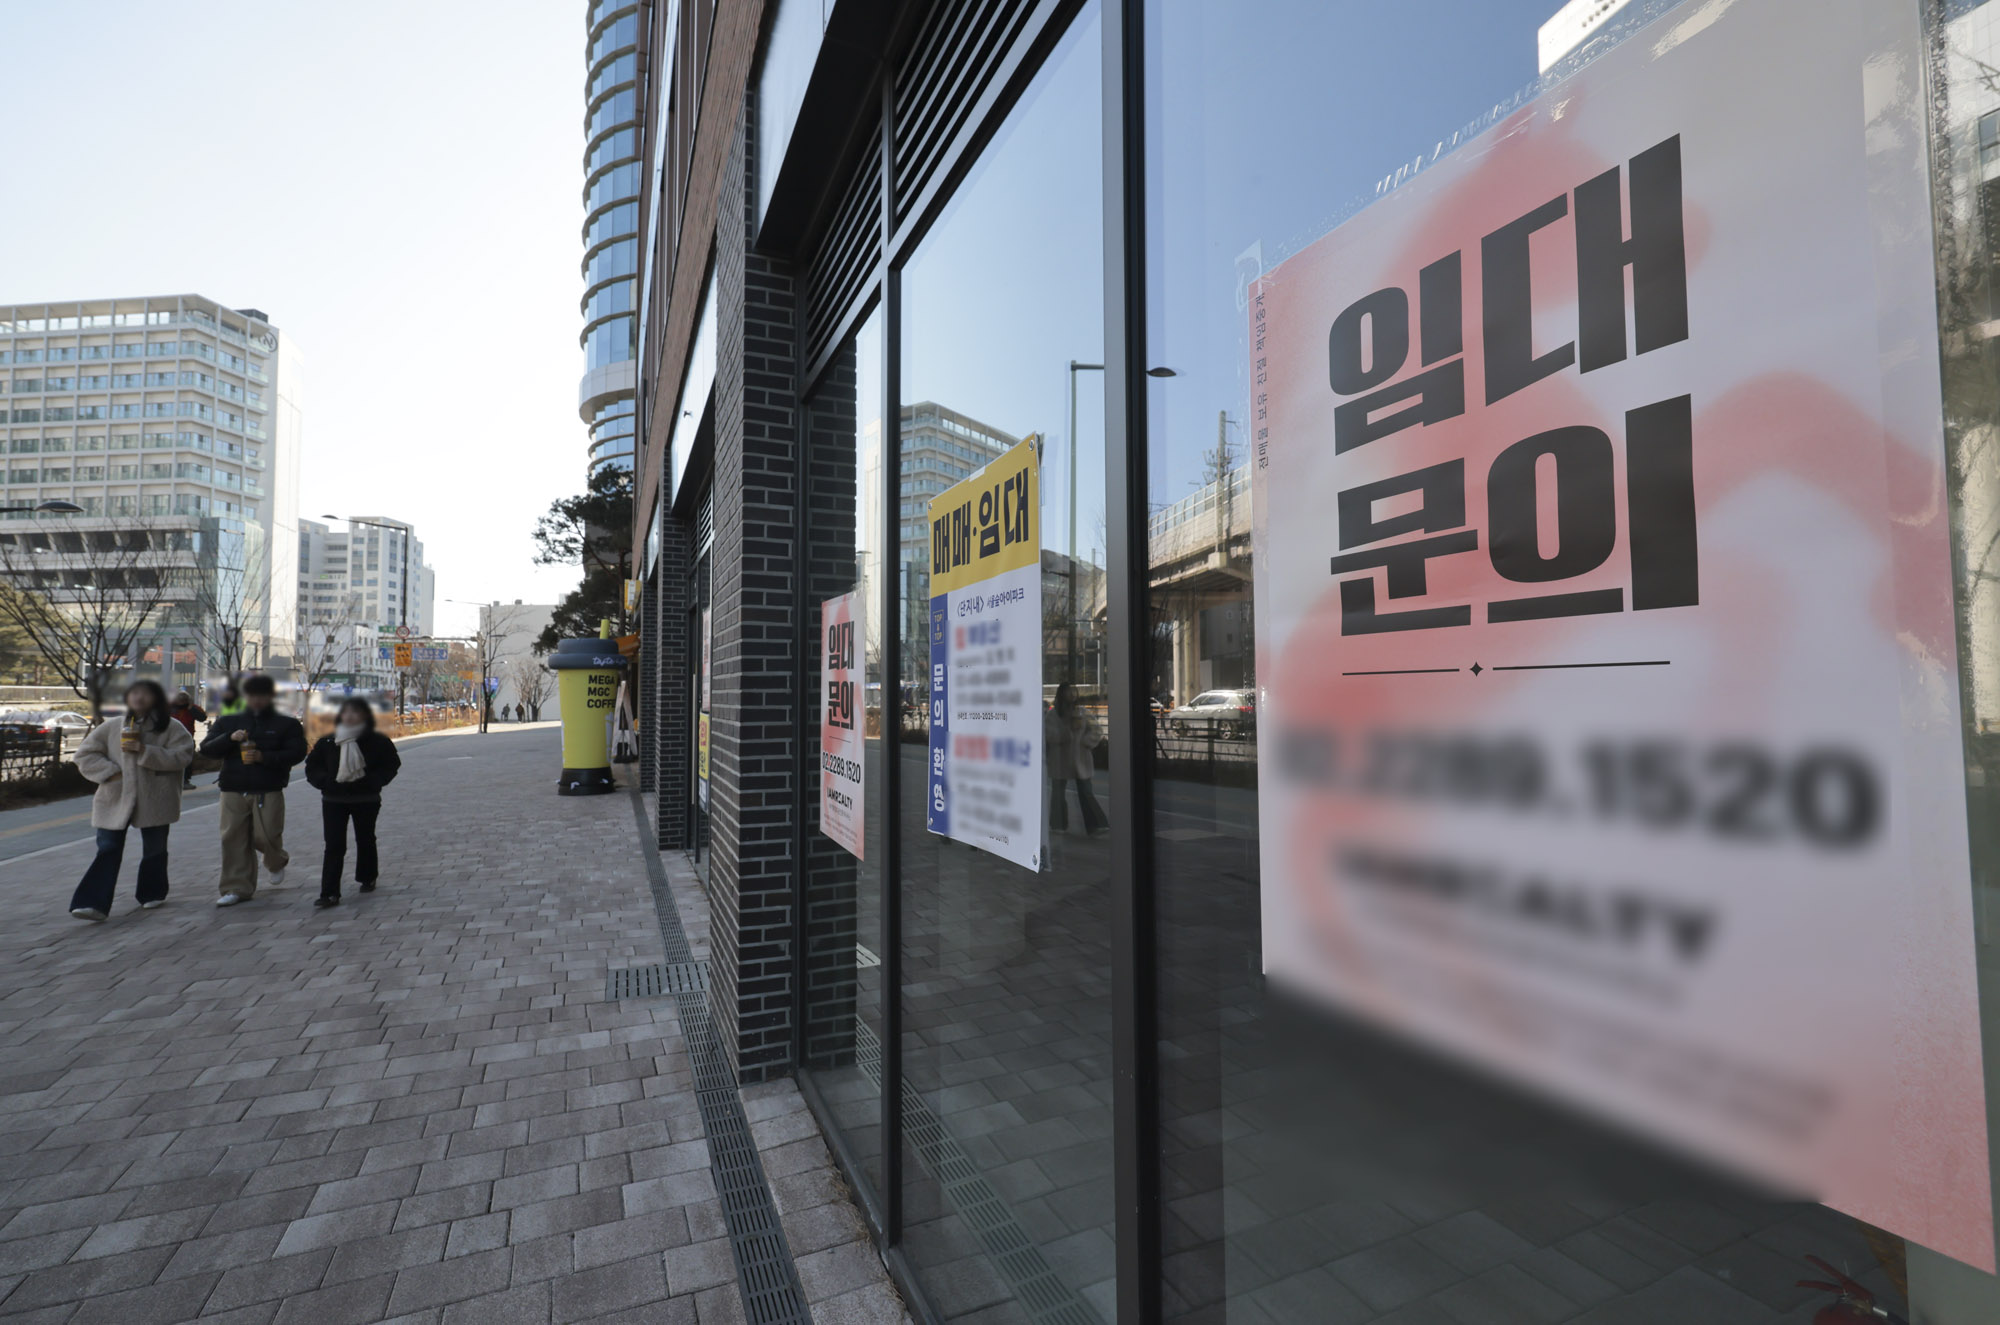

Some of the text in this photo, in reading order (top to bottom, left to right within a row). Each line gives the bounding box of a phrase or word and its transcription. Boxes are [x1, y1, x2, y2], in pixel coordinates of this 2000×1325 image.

[1329, 133, 1688, 456] 임대
[1257, 392, 1267, 420] 보유
[933, 467, 1029, 575] 매매·임대
[1331, 393, 1699, 637] 문의
[828, 620, 855, 670] 임대
[587, 687, 610, 697] MGC
[588, 674, 615, 685] MEGA
[828, 681, 854, 730] 문의
[822, 752, 861, 784] 02.2289.1520
